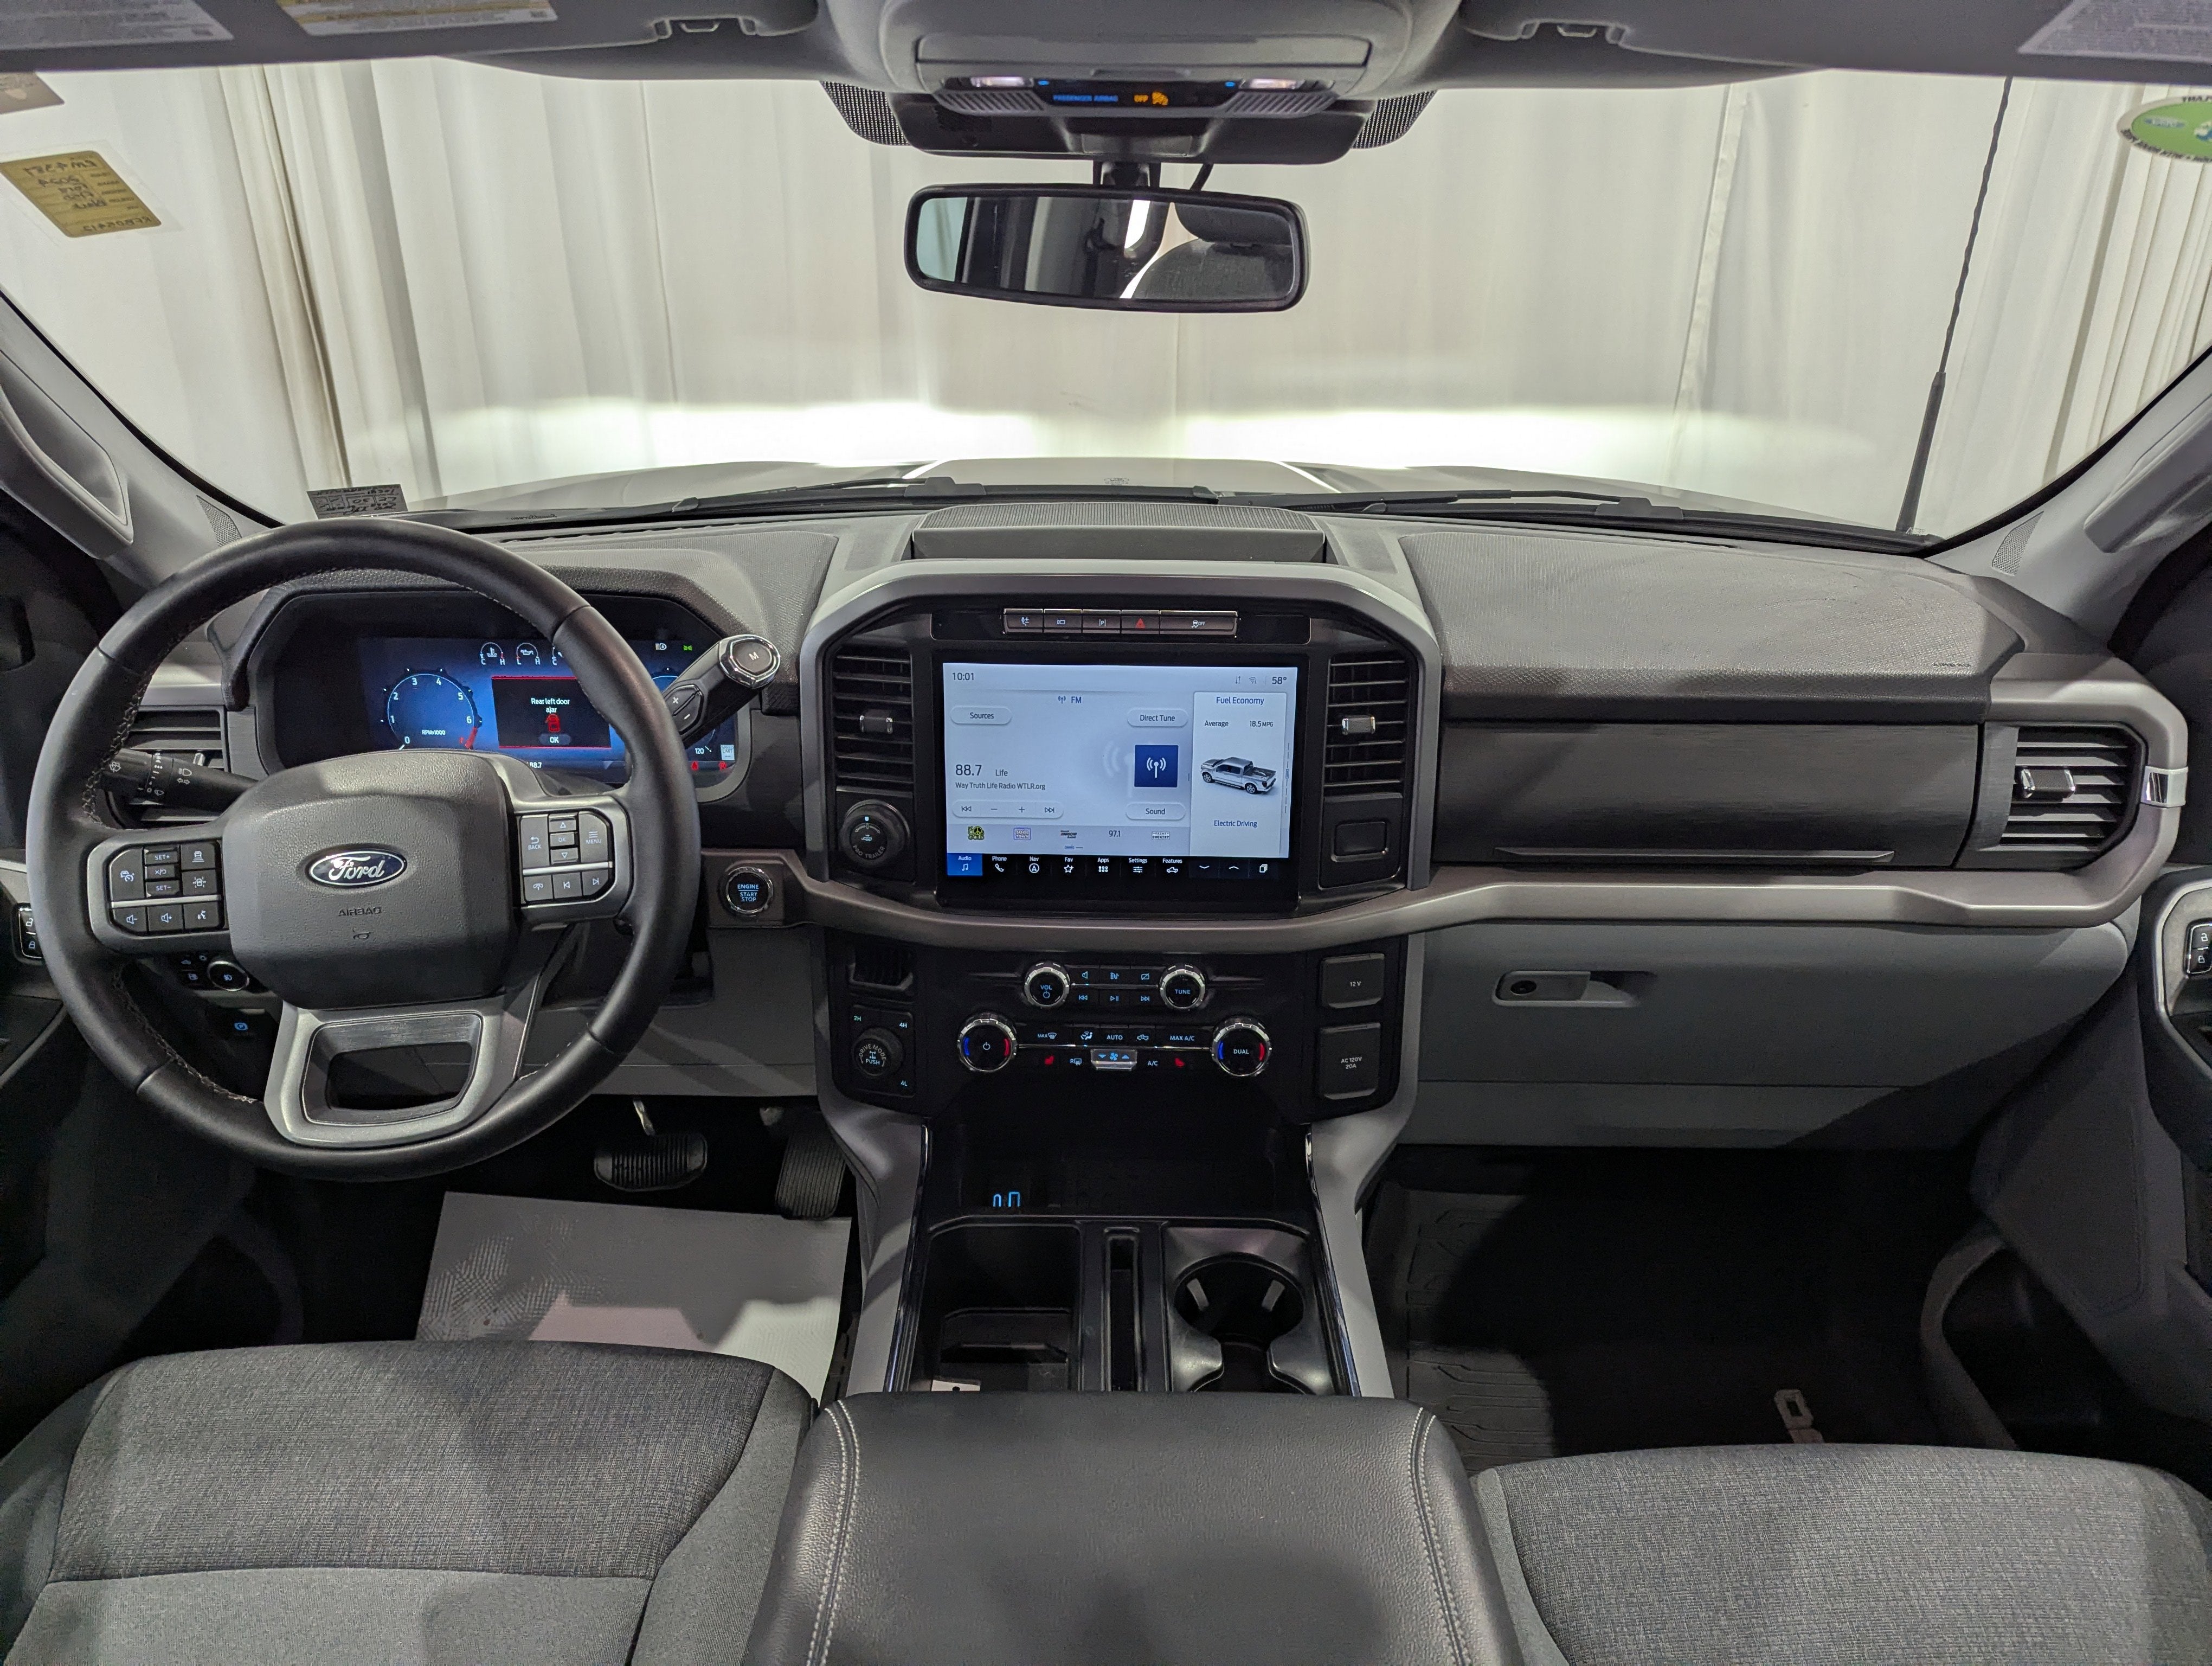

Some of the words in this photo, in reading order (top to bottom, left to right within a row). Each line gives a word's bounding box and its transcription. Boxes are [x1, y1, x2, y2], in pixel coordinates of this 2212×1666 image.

[749, 652, 759, 661] M
[952, 672, 974, 681] 10:01
[412, 678, 417, 686] 3
[436, 678, 442, 686] 4
[393, 692, 399, 700] 2
[458, 692, 464, 700] 5
[1232, 697, 1264, 706] Economy
[390, 715, 395, 723] 1
[404, 736, 410, 744] 0
[955, 764, 982, 776] 88.7
[955, 783, 968, 791] Way
[328, 855, 385, 881] Ford
[338, 906, 382, 917] AIRBAG
[859, 1043, 871, 1058] DRIVE
[873, 1045, 886, 1060] MODE
